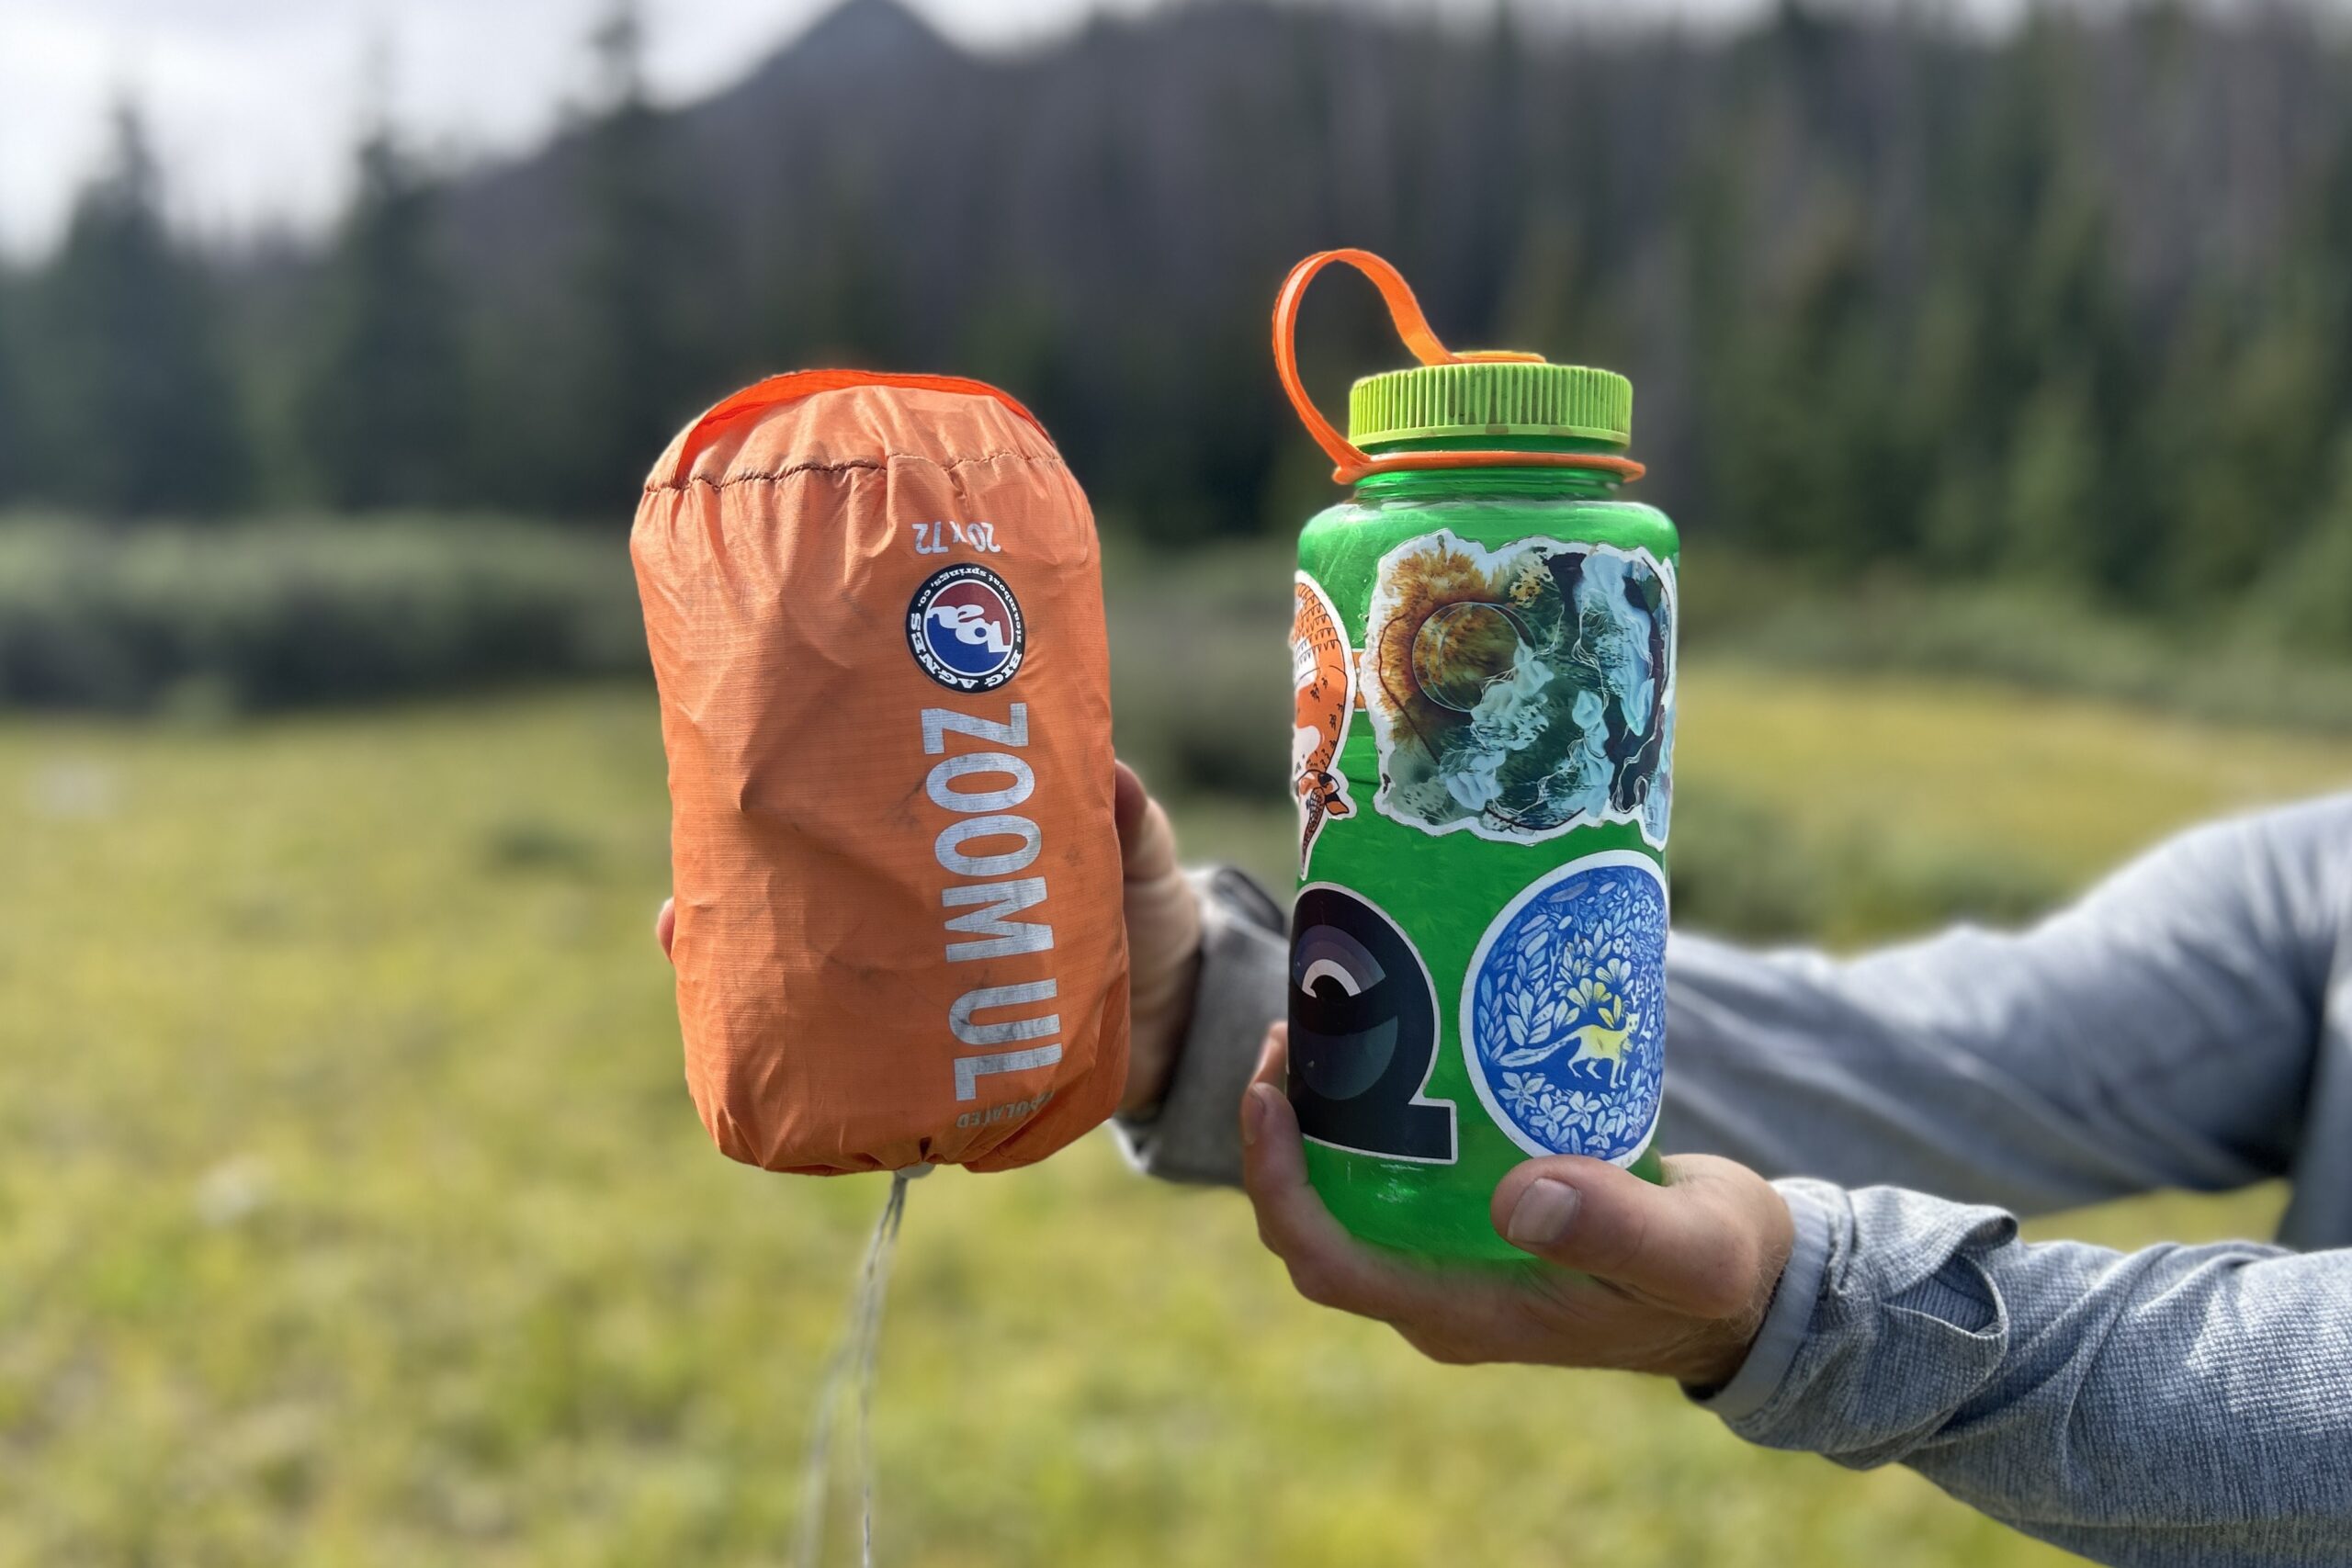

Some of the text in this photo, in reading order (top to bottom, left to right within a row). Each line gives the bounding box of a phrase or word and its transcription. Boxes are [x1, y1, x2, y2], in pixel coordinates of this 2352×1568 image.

[911, 521, 1001, 554] 20 x 72
[910, 613, 1022, 689] BIG AGNES
[921, 703, 1063, 1102] ZOOM UL
